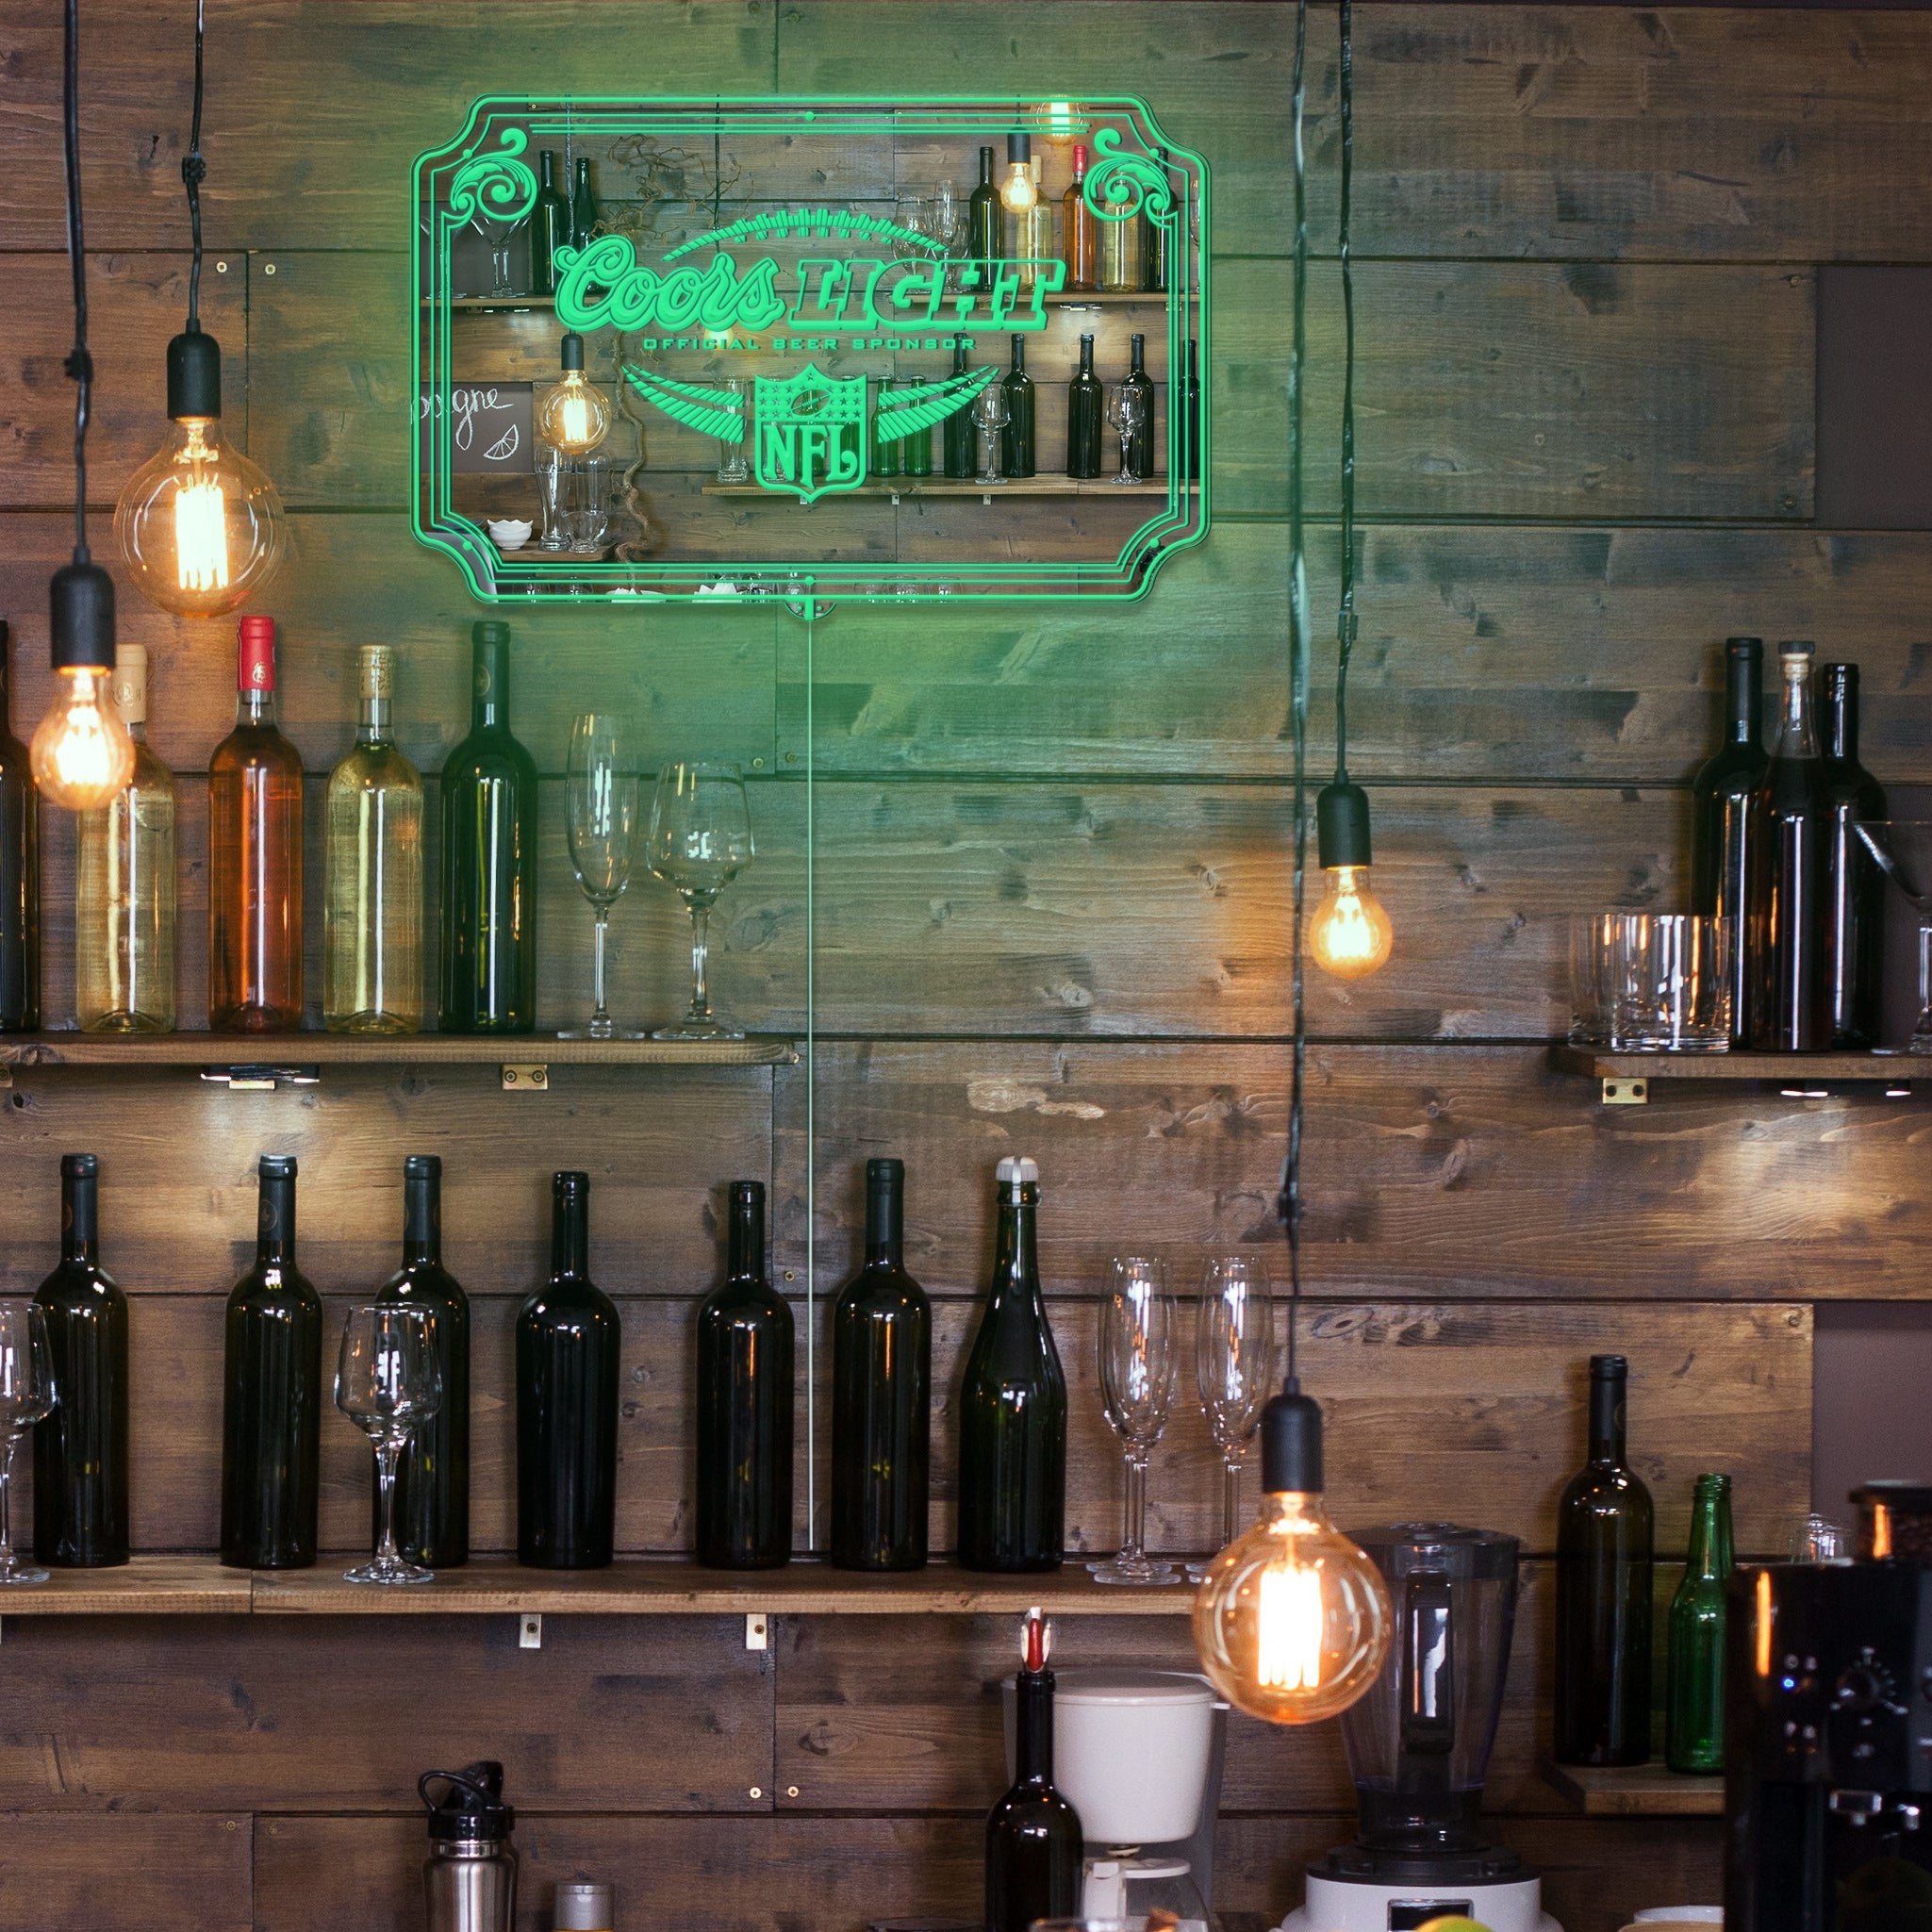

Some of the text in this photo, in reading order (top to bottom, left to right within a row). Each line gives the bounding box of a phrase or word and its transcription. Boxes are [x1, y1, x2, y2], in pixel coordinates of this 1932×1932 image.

[553, 235, 1068, 332] Coors LIGHT
[643, 338, 977, 351] OFFICIAL BEER SPONSOR
[762, 424, 858, 489] NFL
